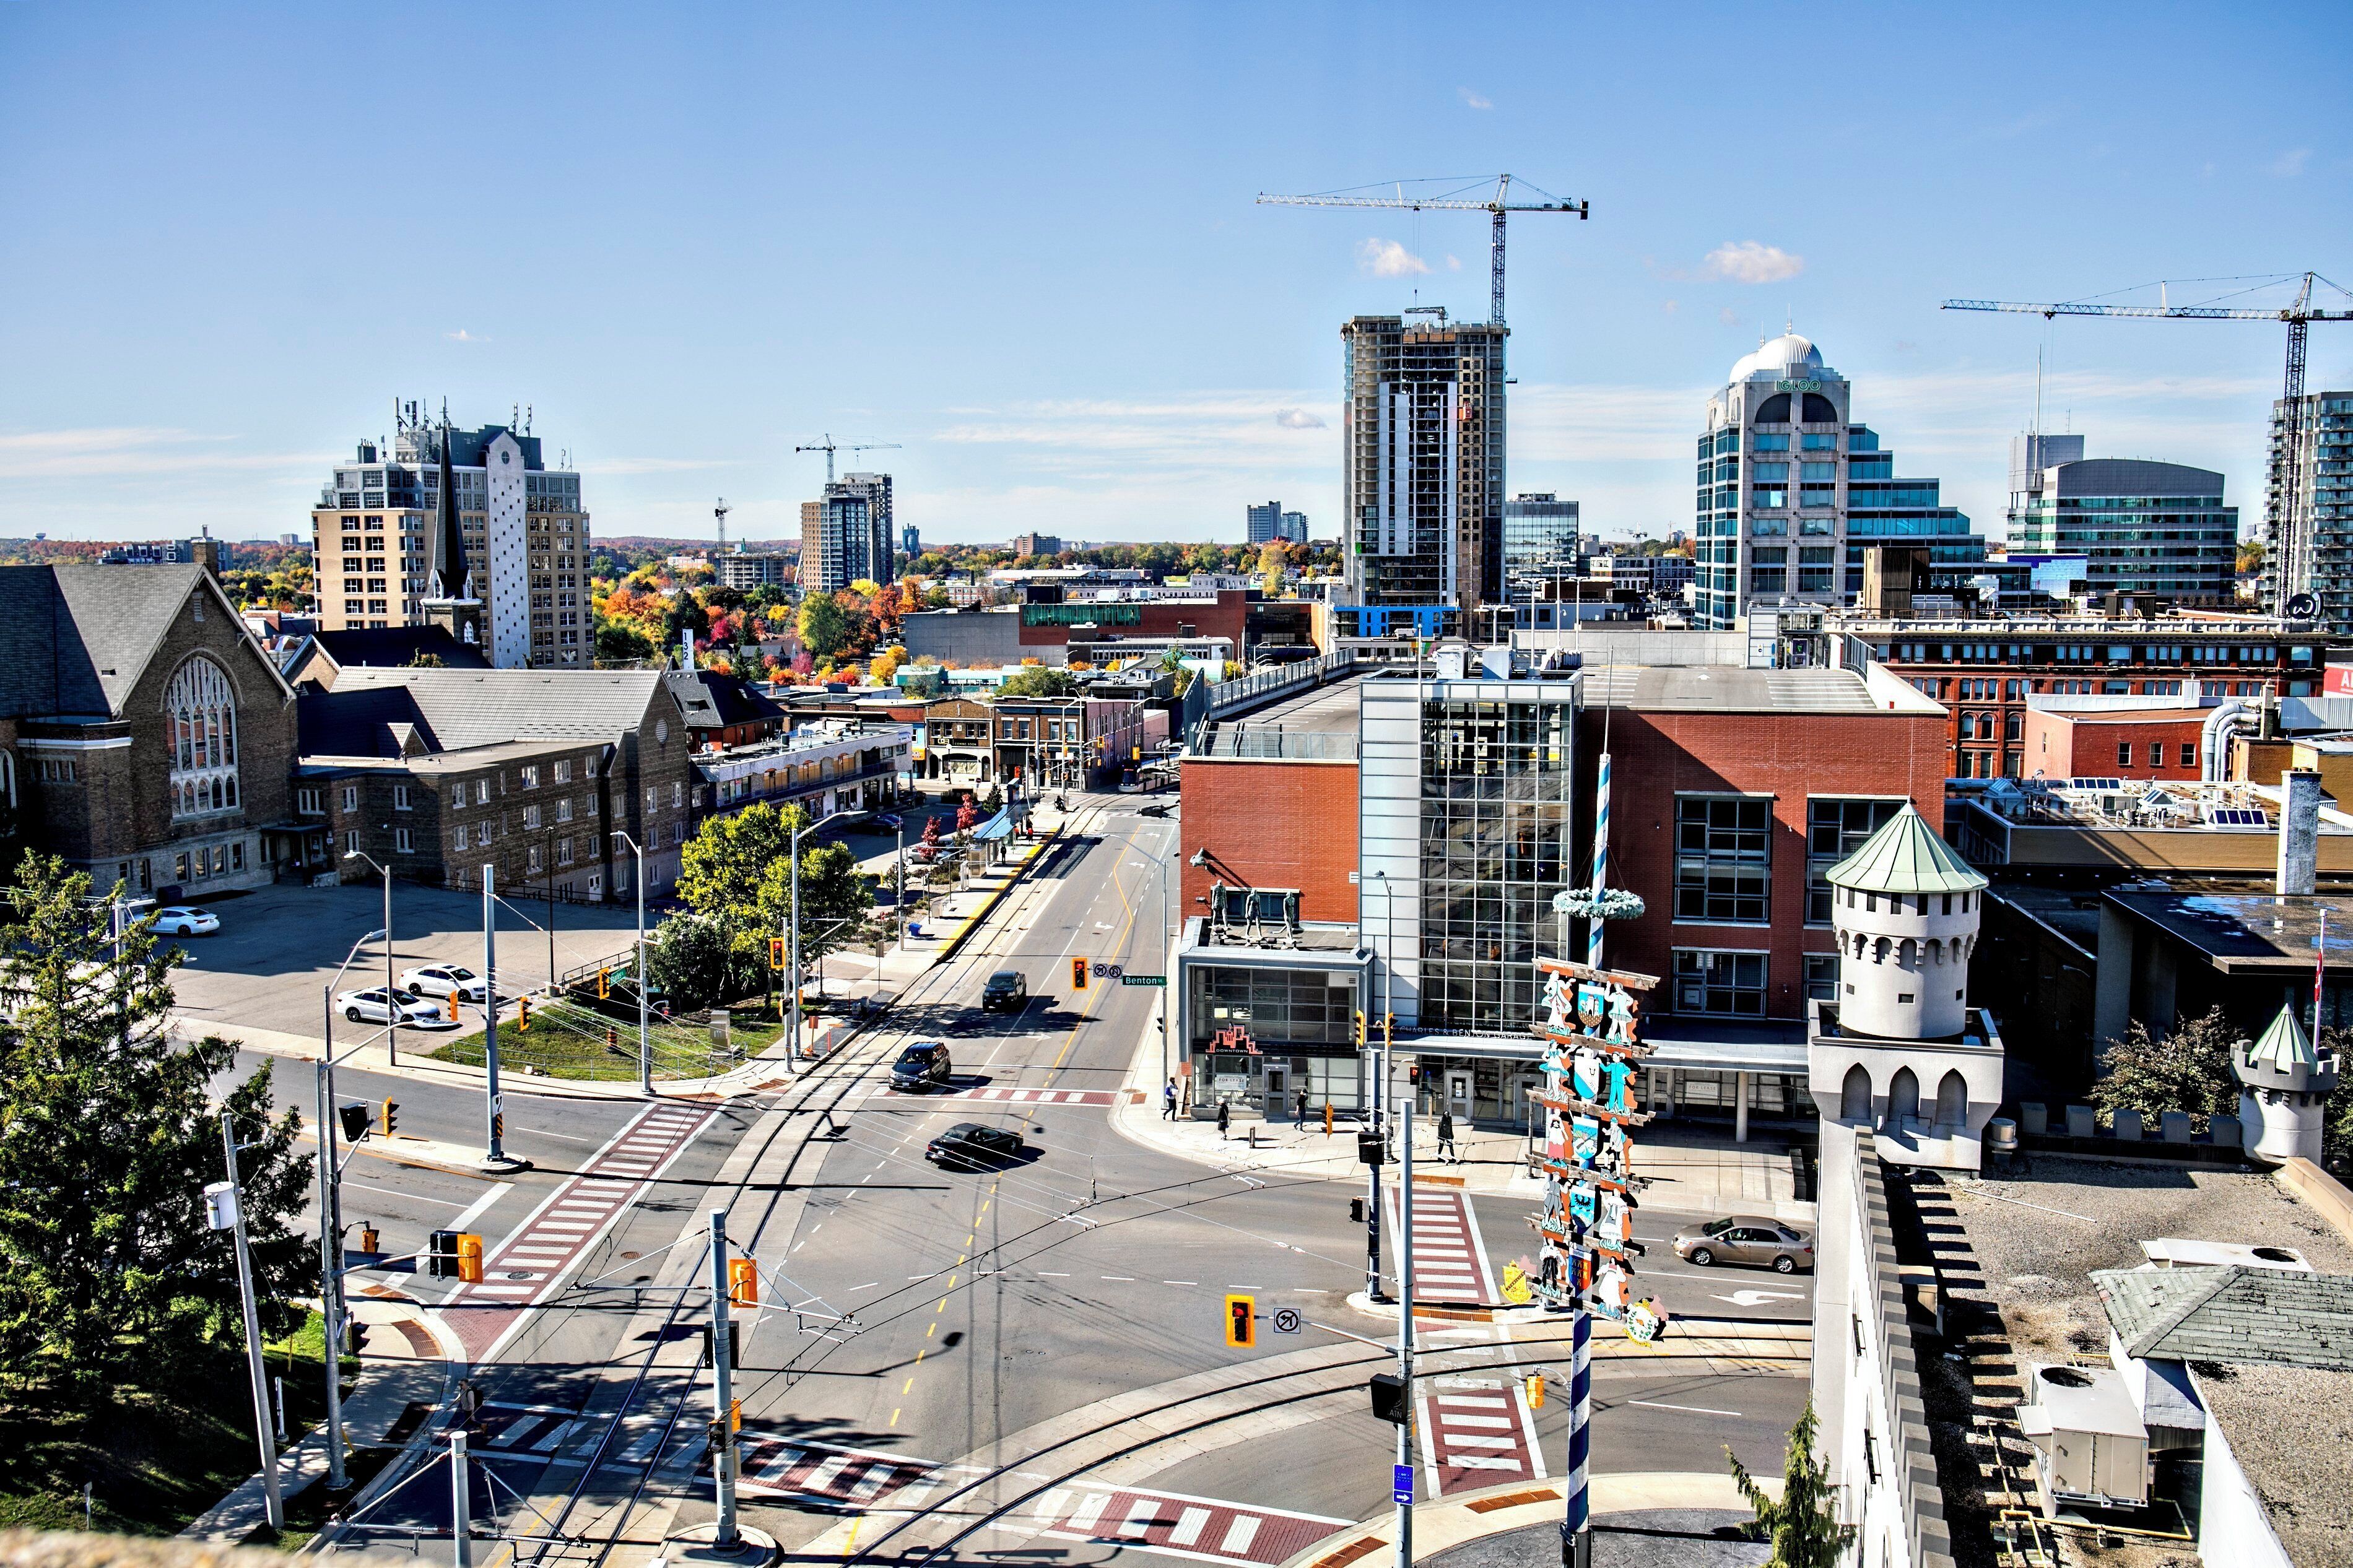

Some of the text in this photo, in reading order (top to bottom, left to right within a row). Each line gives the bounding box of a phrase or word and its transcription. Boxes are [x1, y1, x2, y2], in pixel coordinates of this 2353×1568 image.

[1775, 379, 1821, 391] IGLOO
[1399, 1026, 1439, 1036] CHARLES
[1452, 1028, 1490, 1038] BENTON
[1494, 1031, 1533, 1041] GARAGE
[1627, 1332, 1646, 1345] KITCHENER
